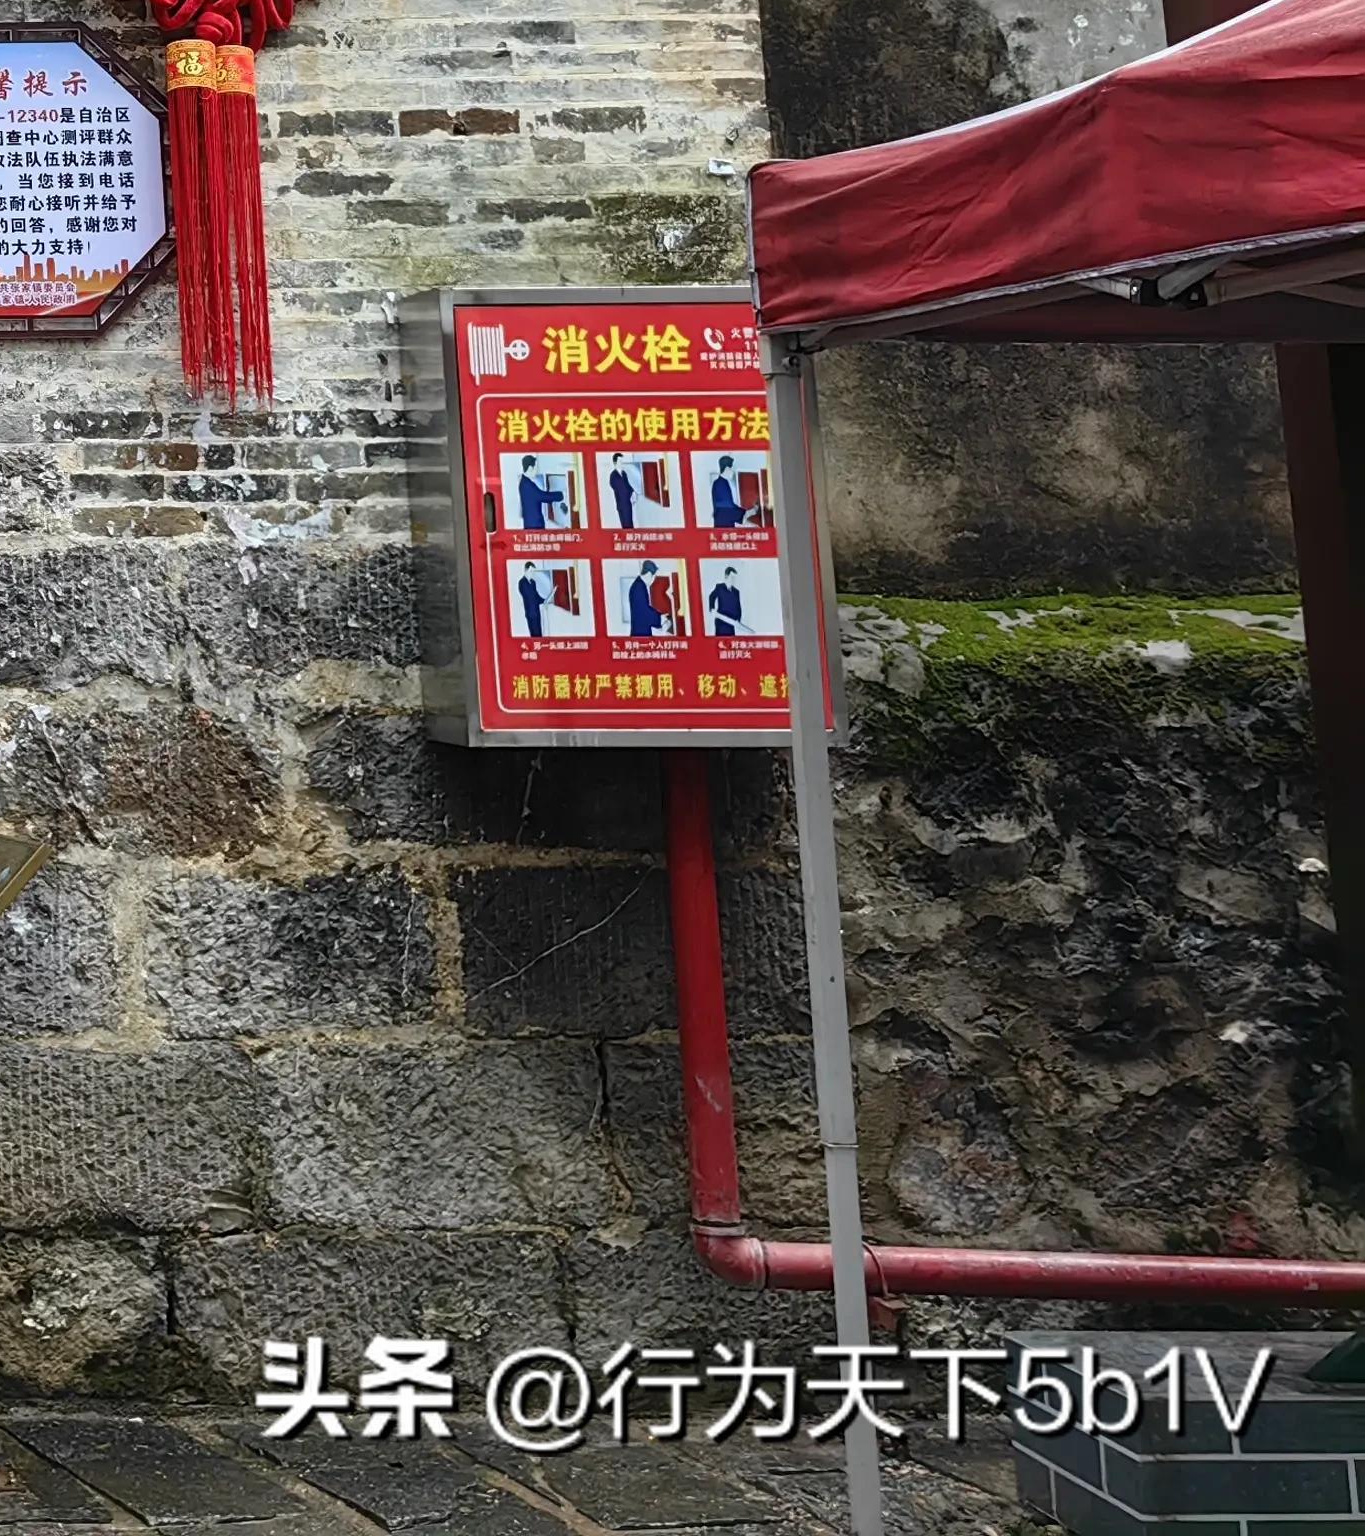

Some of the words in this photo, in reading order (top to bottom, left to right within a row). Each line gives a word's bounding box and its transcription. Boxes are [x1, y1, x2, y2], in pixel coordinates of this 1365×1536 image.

[540, 322, 693, 375] 消火栓
[496, 407, 771, 445] 消火栓的使用方法
